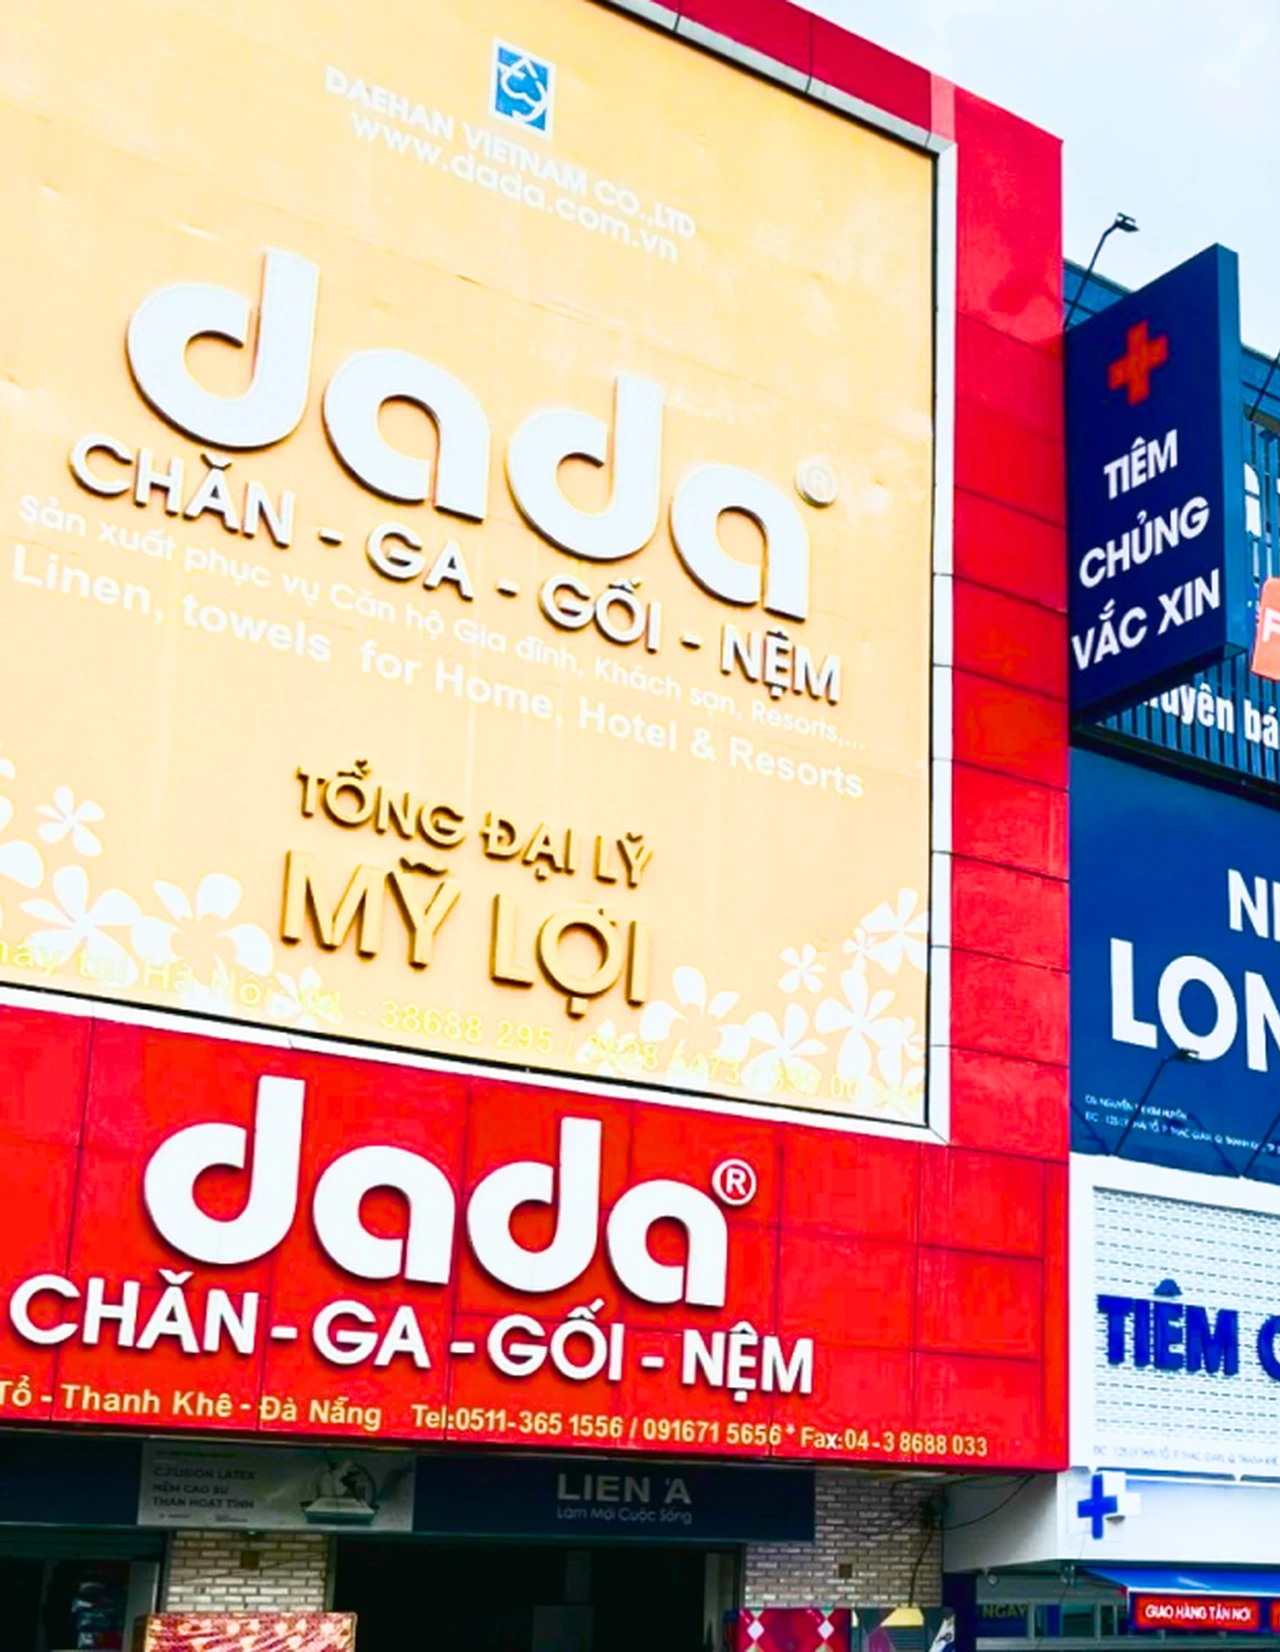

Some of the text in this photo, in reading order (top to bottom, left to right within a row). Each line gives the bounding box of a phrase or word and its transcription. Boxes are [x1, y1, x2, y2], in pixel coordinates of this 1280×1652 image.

[324, 64, 454, 140] DAEHAN
[462, 122, 588, 197] VIETNAM
[351, 111, 678, 263] www.dada.com.vn
[1103, 429, 1180, 502] TIÊM
[68, 432, 841, 706] CHĂN GA GỐI NỆM
[1078, 495, 1212, 590] CHỦNG
[17, 493, 86, 537] Sản
[97, 520, 176, 562] xuất
[184, 545, 272, 588] phục
[281, 569, 320, 608] vụ
[405, 602, 446, 640] hộ
[594, 655, 683, 701] Khách
[1071, 567, 1221, 671] VẮC XIN
[11, 544, 865, 800] Linen, towels for Home, Hotel & Resorts
[1143, 682, 1235, 734] uyên
[479, 810, 583, 882] ĐẠI
[280, 849, 652, 1020] MỸ LỢI
[496, 1019, 555, 1053] 295
[144, 1075, 728, 1308] dada
[8, 1268, 815, 1405] CHĂN GA GỐI NỆM
[1096, 1278, 1240, 1377] TIÊM
[60, 1383, 161, 1414] Thanh
[172, 1389, 233, 1418] Khê
[259, 1395, 297, 1422] Đà
[309, 1395, 383, 1432] Nẵng
[569, 1415, 624, 1439] 1556
[643, 1418, 719, 1444] 091671
[900, 1431, 947, 1455] 8688
[952, 1434, 988, 1457] 033
